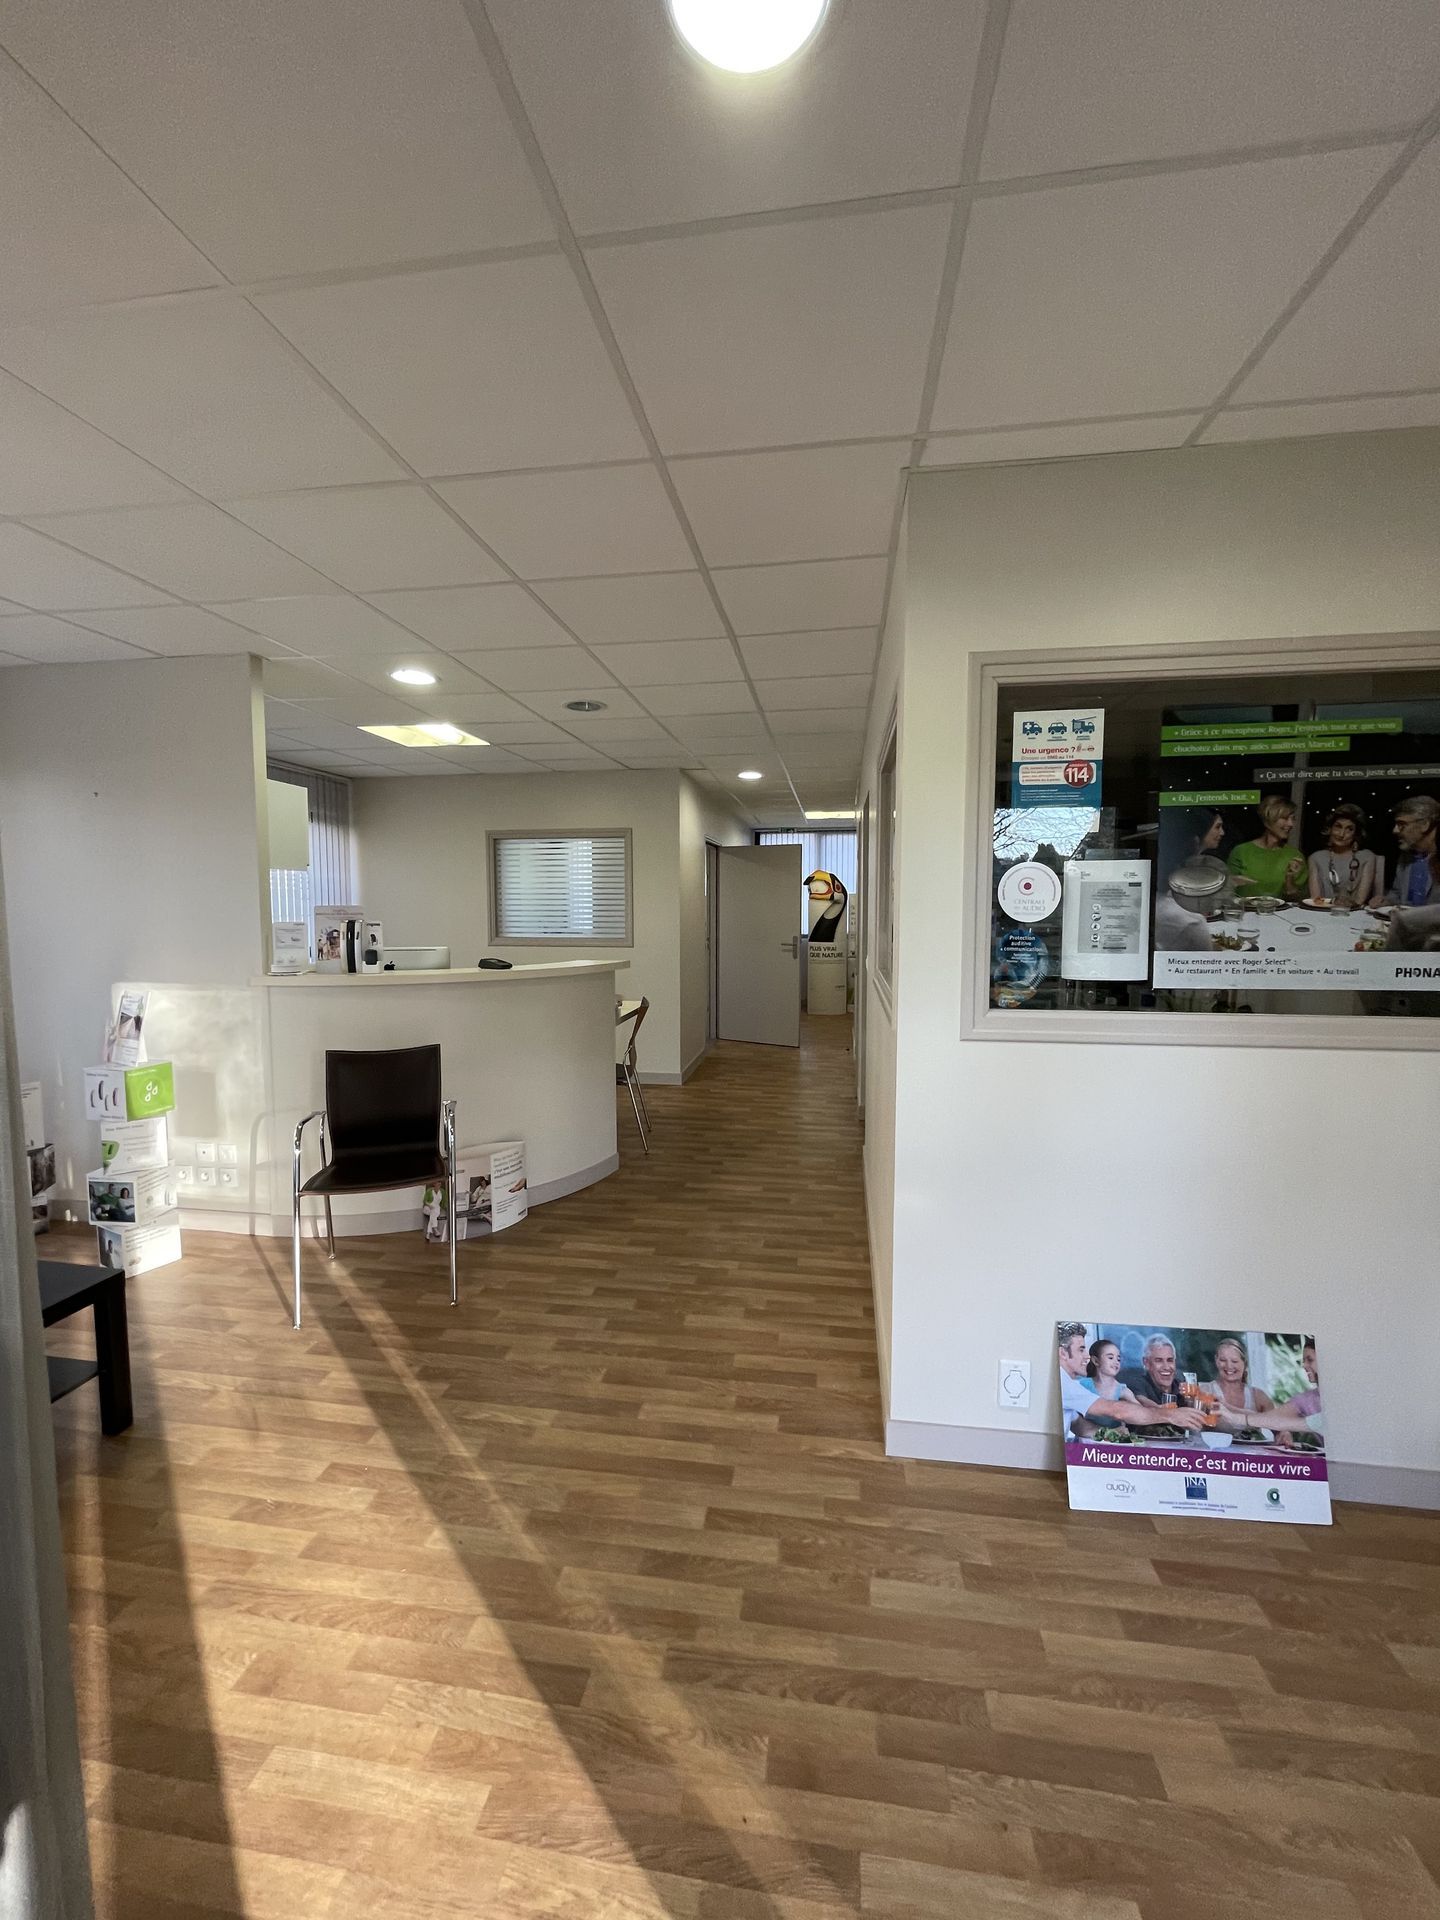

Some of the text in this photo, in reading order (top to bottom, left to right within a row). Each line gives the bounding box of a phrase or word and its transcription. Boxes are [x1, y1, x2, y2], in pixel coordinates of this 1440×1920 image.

[1066, 767, 1089, 782] 114
[1082, 1448, 1311, 1476] Mieux entendre, c'est mieux vivre
